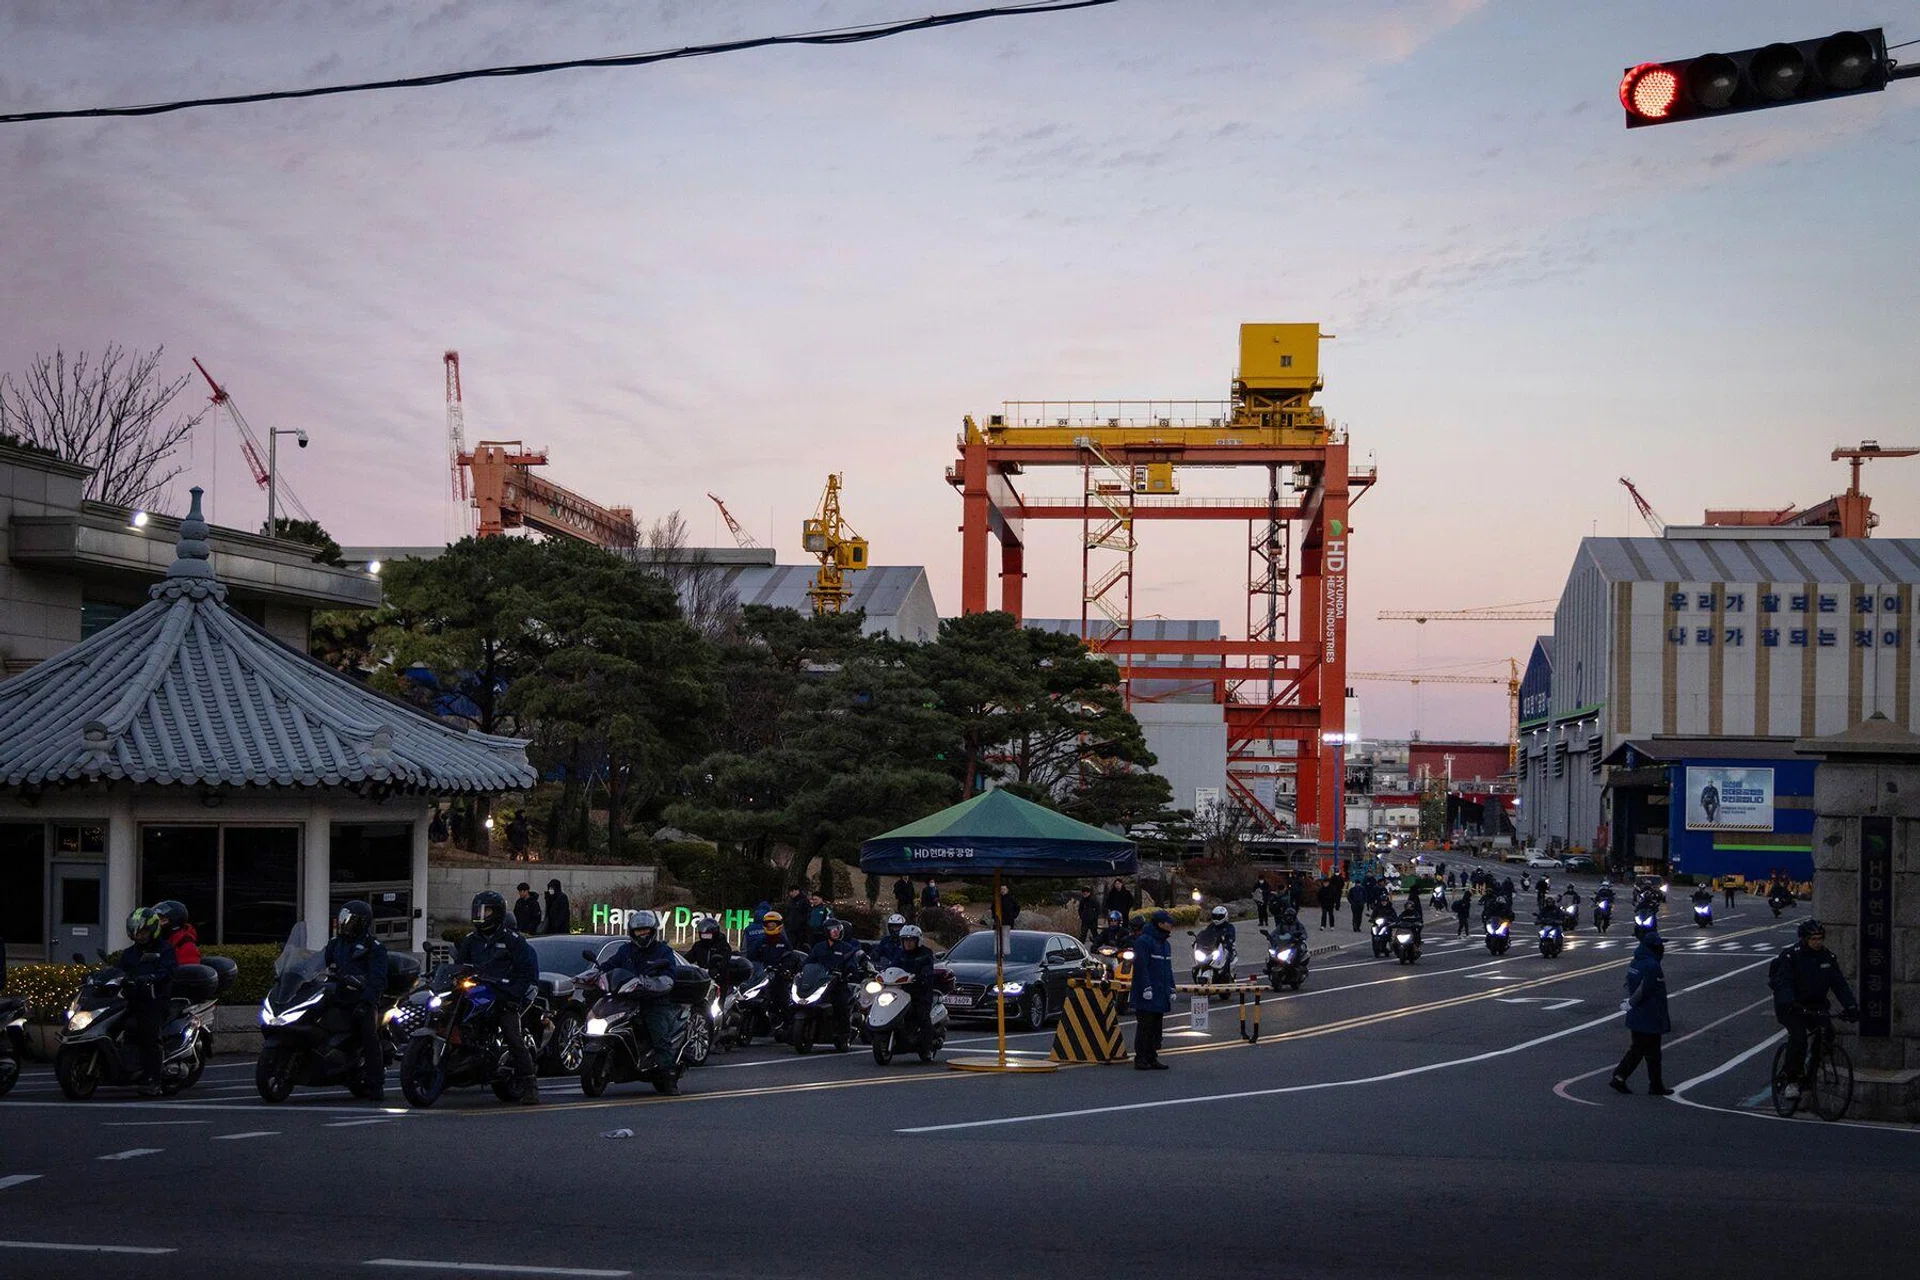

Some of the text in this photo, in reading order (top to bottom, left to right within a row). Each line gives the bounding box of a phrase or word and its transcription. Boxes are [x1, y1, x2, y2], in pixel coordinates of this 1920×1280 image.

[1327, 540, 1345, 572] HD
[1336, 575, 1345, 619] HYUNDAI
[1669, 593, 1744, 613] 우리가
[1855, 594, 1902, 614] 것이
[1325, 575, 1336, 664] HEAVY INDUSTRIES
[1668, 627, 1743, 647] 나라가
[1855, 629, 1901, 648] 것이
[914, 847, 974, 859] HD현대중공업
[592, 903, 671, 930] Hapy
